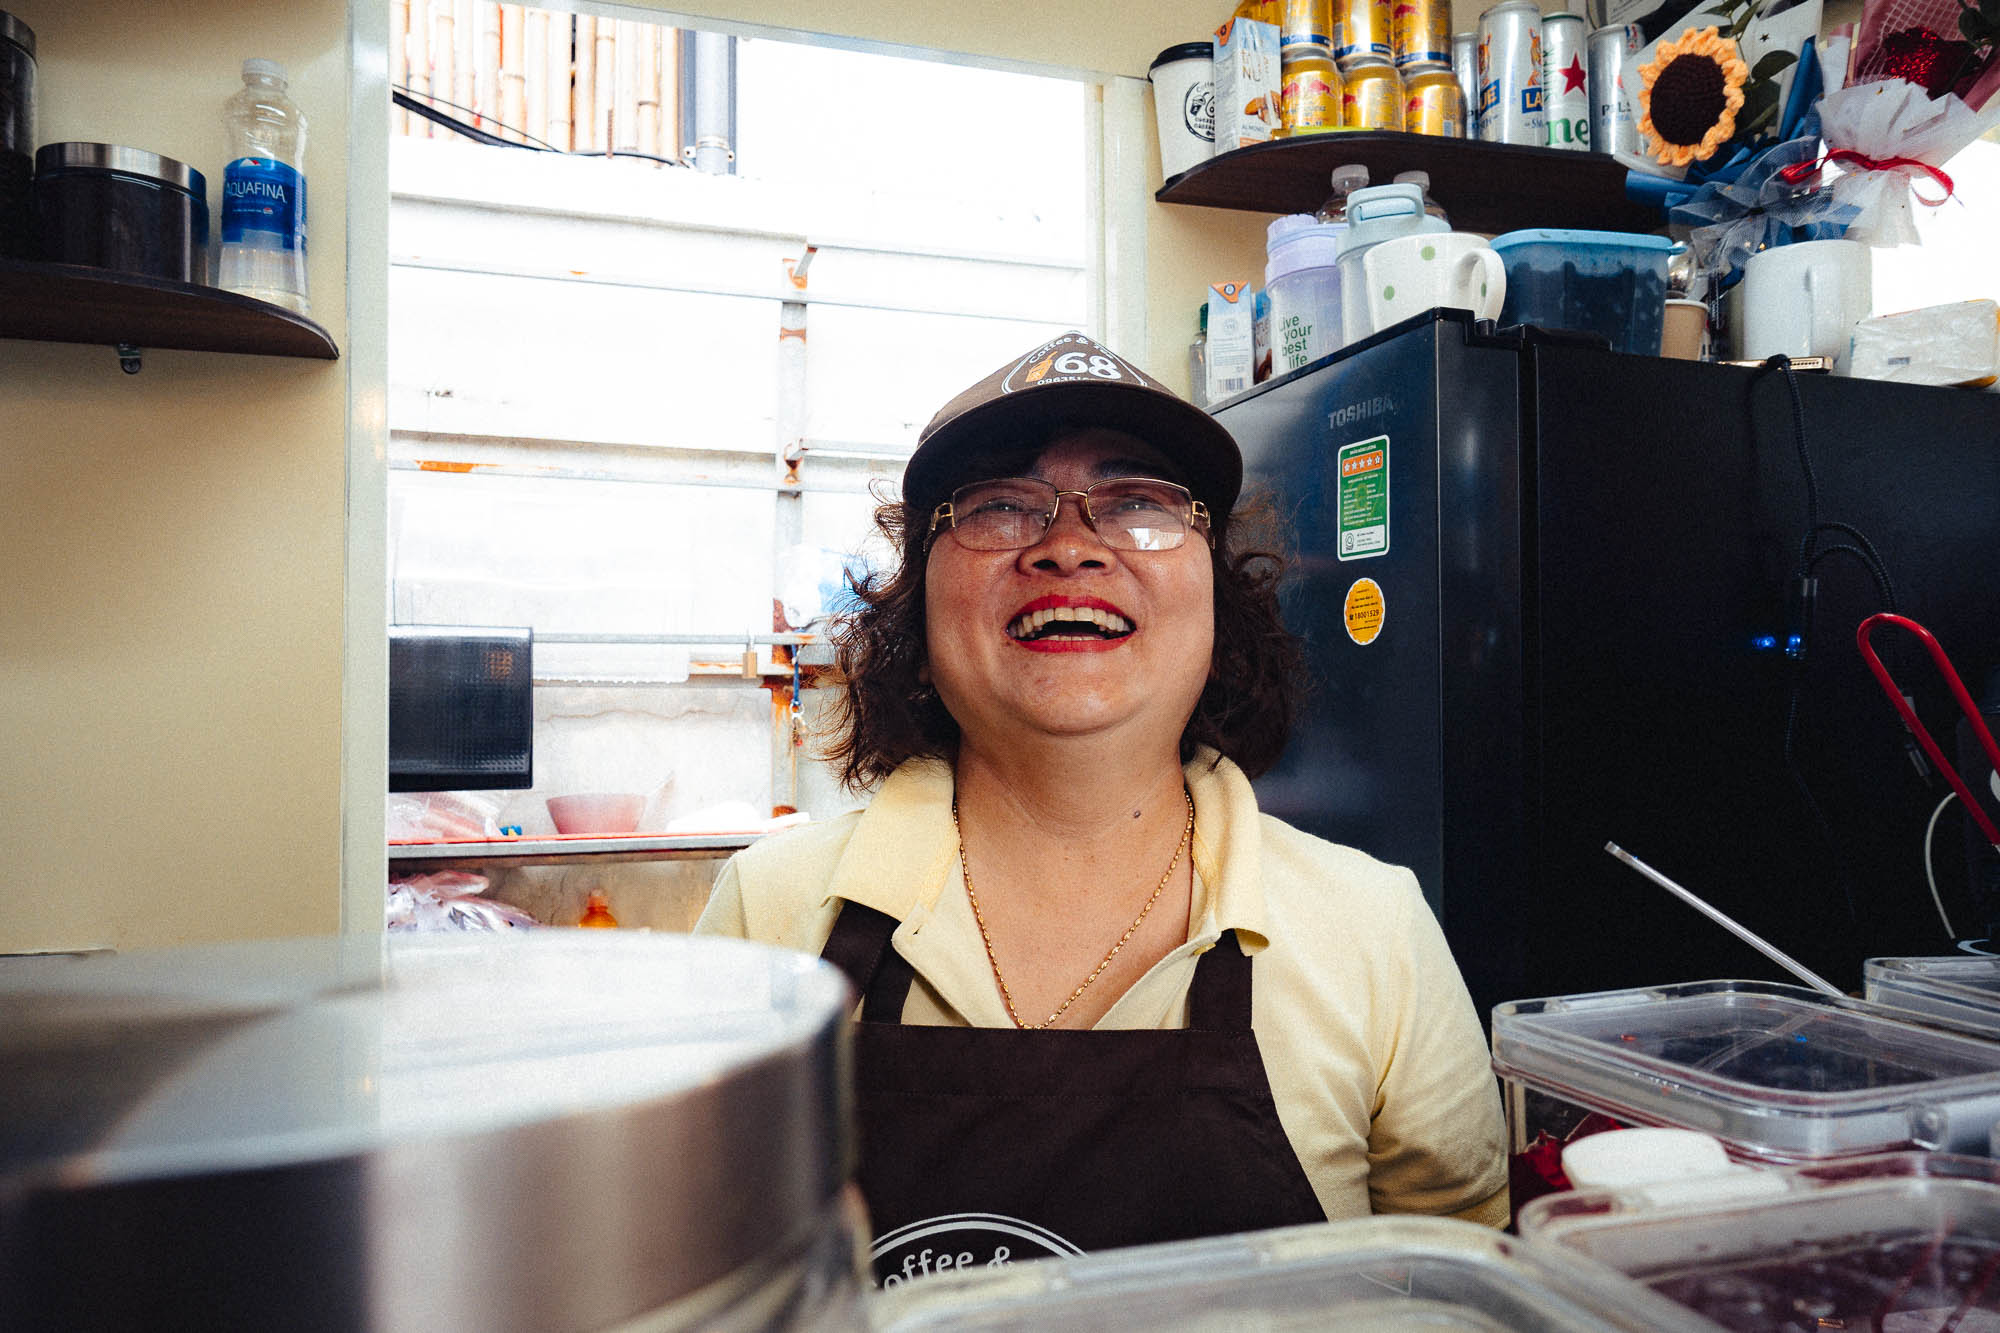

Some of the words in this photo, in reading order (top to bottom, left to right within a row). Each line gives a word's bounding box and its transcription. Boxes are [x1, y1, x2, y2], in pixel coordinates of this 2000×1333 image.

[226, 182, 288, 204] AQUAFINA
[1284, 324, 1313, 344] your
[1281, 338, 1307, 357] best
[1054, 351, 1122, 380] 68
[1288, 353, 1308, 369] life
[1328, 397, 1394, 429] TOSHIBA
[871, 1247, 974, 1292] offee
